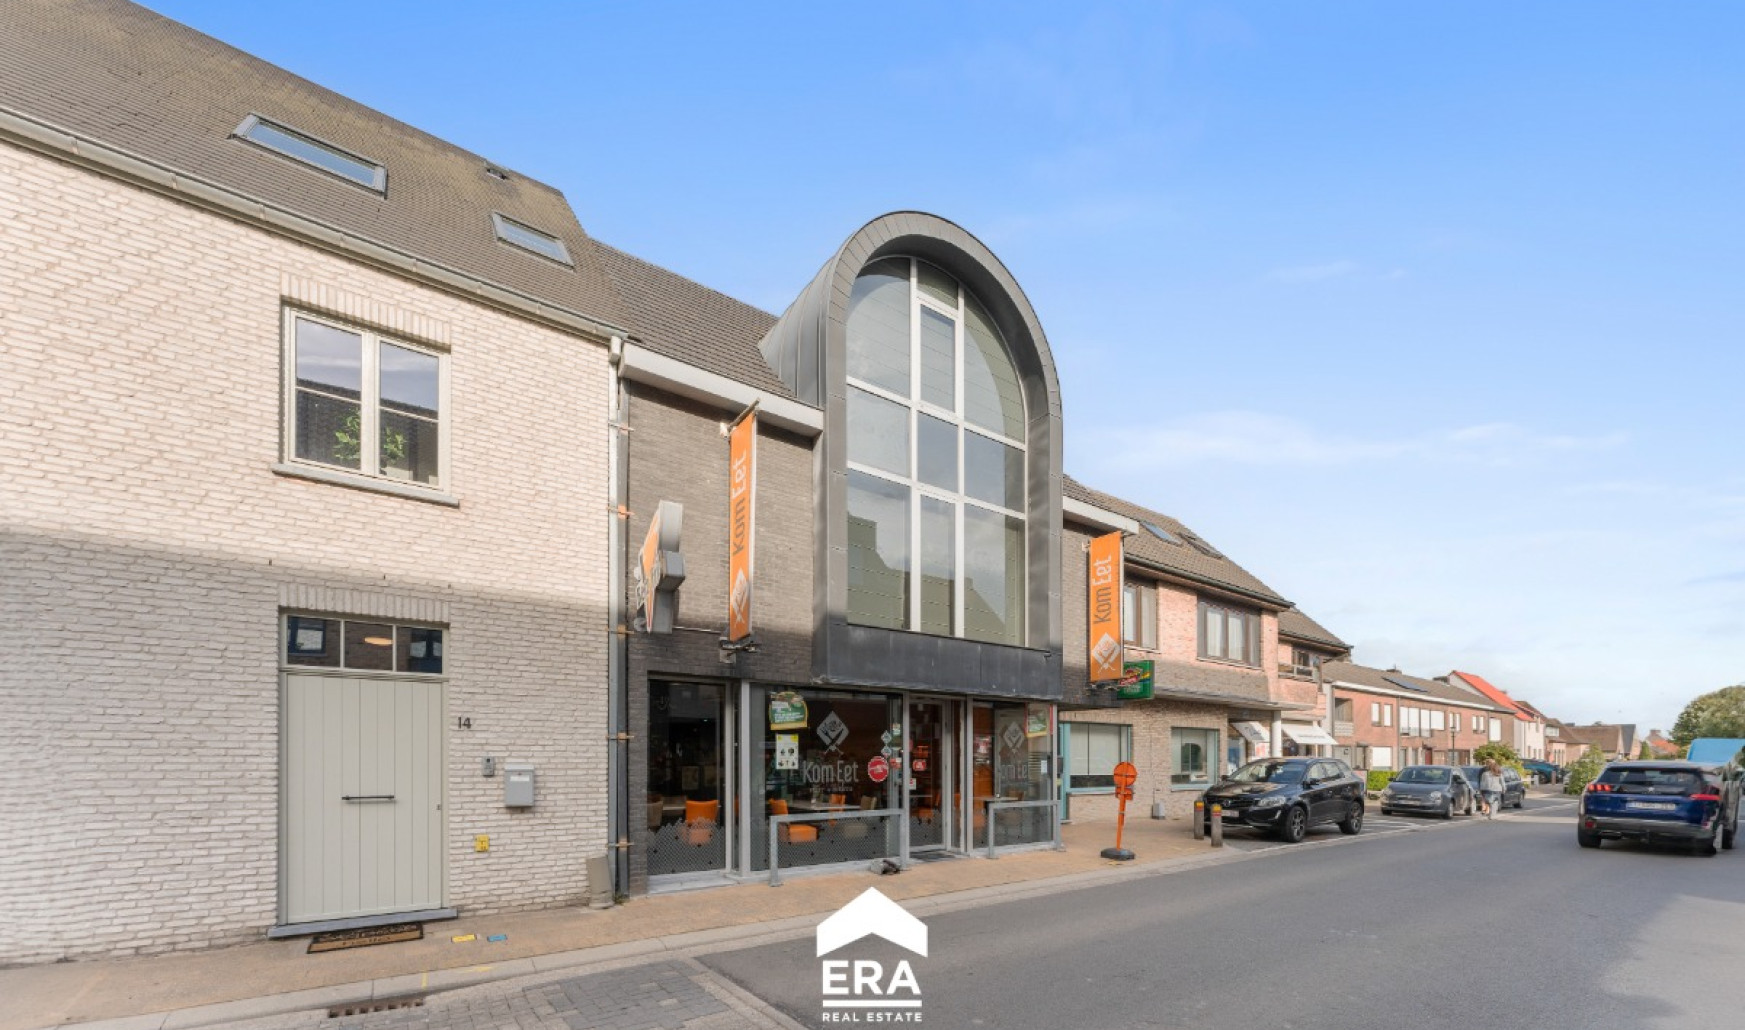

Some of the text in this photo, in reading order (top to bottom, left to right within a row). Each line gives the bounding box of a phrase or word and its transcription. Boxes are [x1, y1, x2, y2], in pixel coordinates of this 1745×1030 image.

[732, 448, 747, 556] Kom Eet
[1092, 555, 1112, 625] Kom Eet
[458, 716, 472, 729] 14
[802, 760, 834, 784] Kom
[837, 760, 859, 782] Eet
